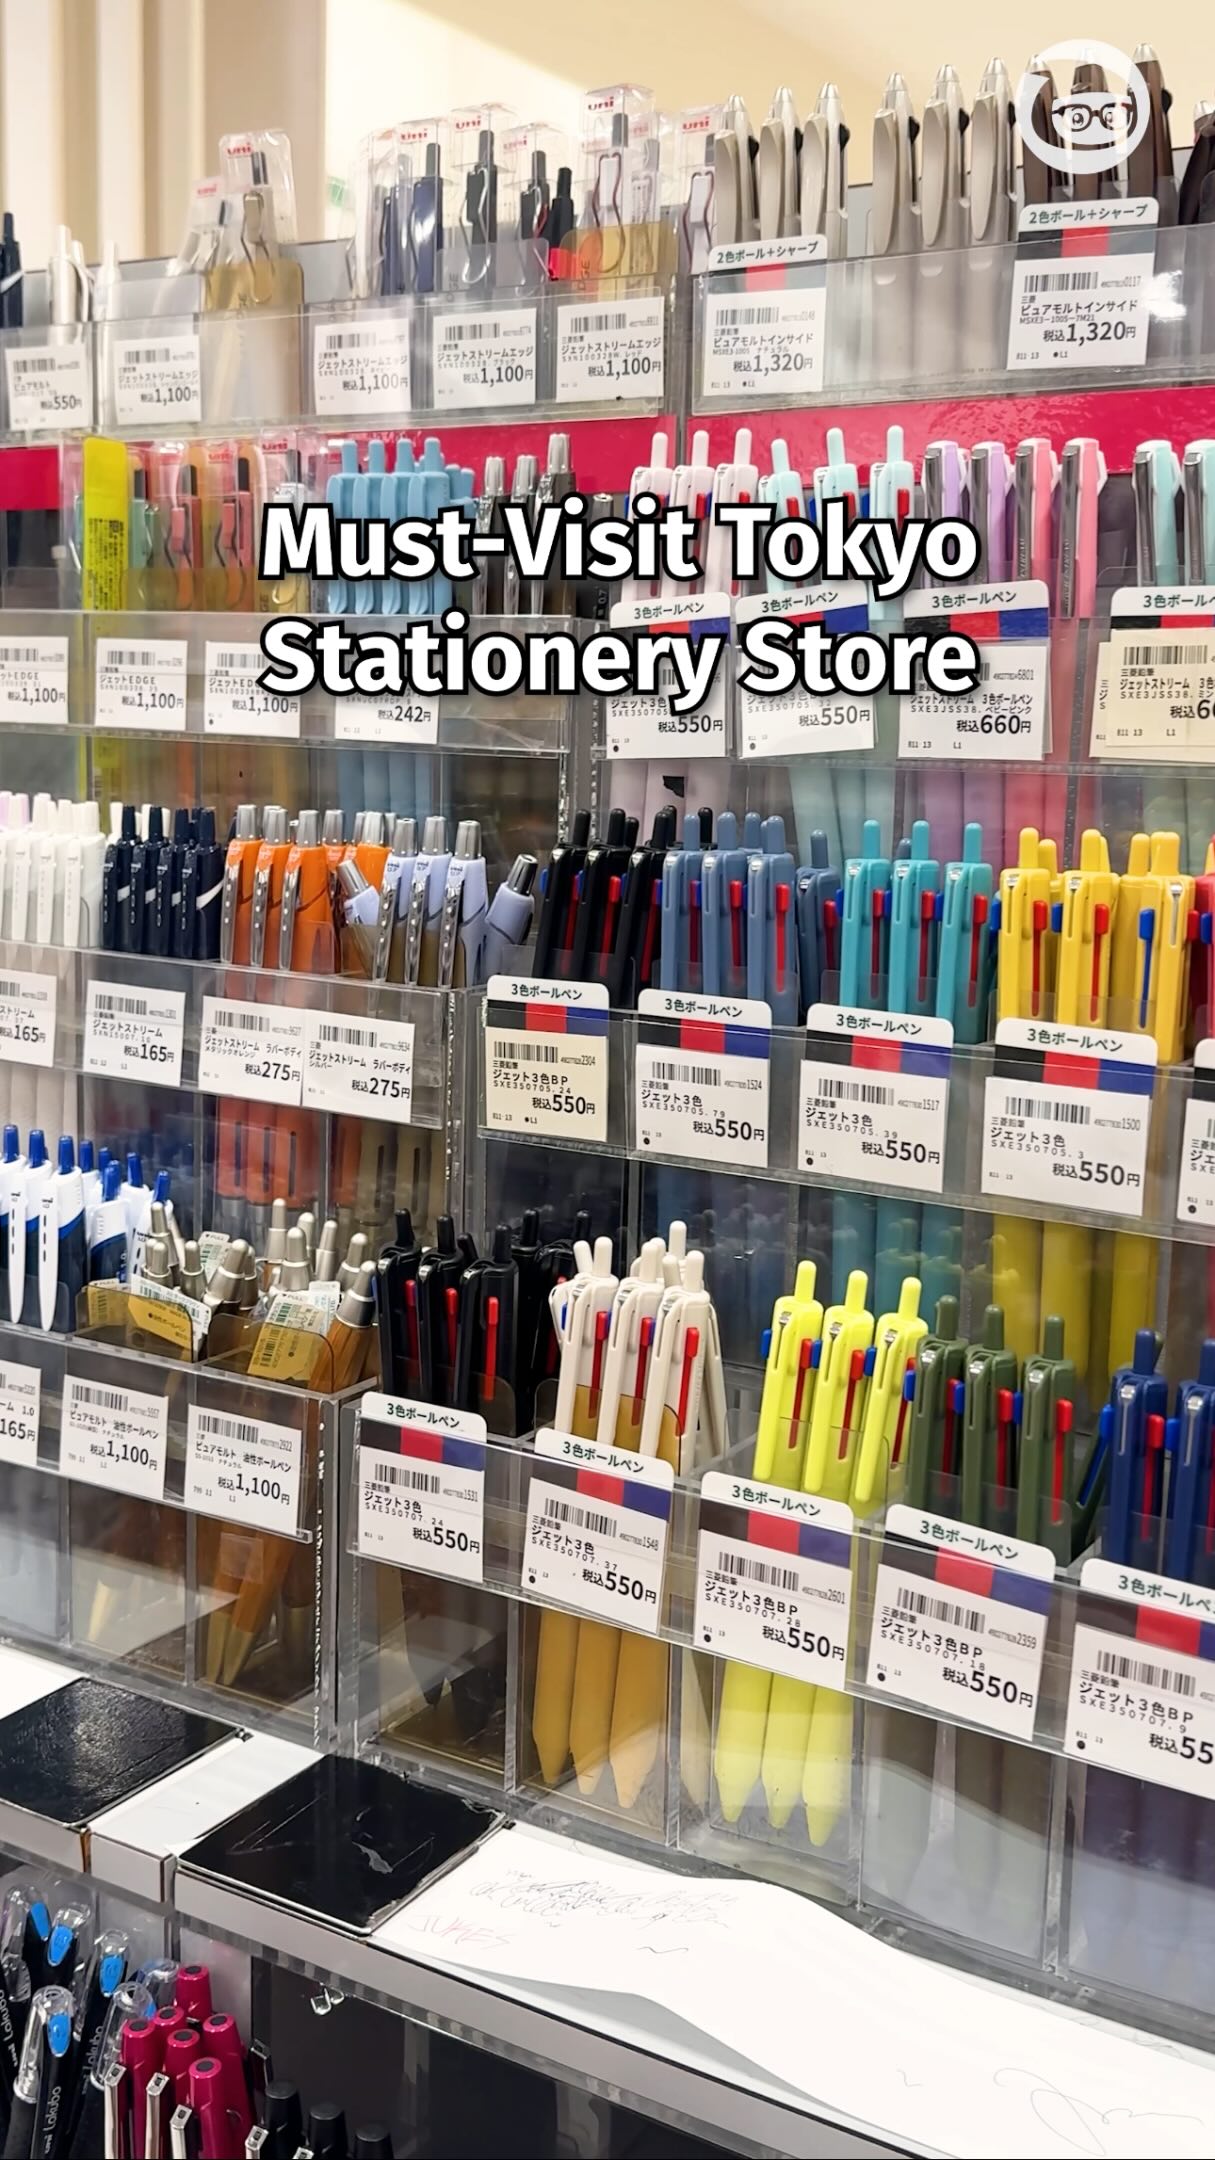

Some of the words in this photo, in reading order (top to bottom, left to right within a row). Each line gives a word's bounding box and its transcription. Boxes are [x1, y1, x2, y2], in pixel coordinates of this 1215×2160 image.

[1020, 299, 1138, 317] ピュアモルトインサイド
[713, 333, 814, 349] ピュアモルトインサイド
[1042, 320, 1136, 346] 税込1,320円
[437, 346, 534, 362] ジェットストリームエッジ
[561, 337, 661, 356] ジェットストリームエッジ
[588, 357, 661, 381] 税込1,100円
[733, 353, 813, 376] 税込1,320円
[342, 373, 408, 394] 税込1,100円
[463, 365, 533, 387] 税込1,100円
[40, 395, 82, 410] 税込550円
[140, 386, 199, 406] 税込1,100円
[761, 590, 839, 613] 3色ボールペン
[932, 591, 1017, 609] 3色ボールペン
[634, 602, 705, 620] 3色ボールペン
[1120, 678, 1190, 690] ジェットストリーム
[8, 688, 66, 705] 税込1,100円
[122, 693, 184, 711] 税込1,100円
[232, 697, 298, 716] 税込1,100円
[378, 705, 431, 722] 税込242円
[658, 715, 723, 733] 税込550円
[799, 705, 870, 726] 税込550円
[956, 715, 1031, 734] 税込660円
[511, 983, 582, 1001] 3色ボールペン
[665, 998, 743, 1018] 3色ボールペン
[93, 1019, 163, 1038] ジェットストリーム
[836, 1014, 922, 1035] 3色ボールペン
[204, 1035, 260, 1052] ジェットストリーム
[1027, 1028, 1124, 1053] 3色ボールペン
[124, 1043, 175, 1062] 税込165円
[309, 1051, 366, 1068] ジェットストリーム
[373, 1059, 411, 1075] ラバーボディ
[244, 1061, 301, 1082] 税込275円
[309, 1060, 332, 1070] シルバー
[493, 1069, 568, 1085] ジェット3色BP
[351, 1077, 410, 1099] 税込275円
[641, 1088, 703, 1107] ジェット3色
[532, 1093, 596, 1115] 税込550円
[805, 1107, 873, 1128] ジェット3色
[693, 1118, 765, 1142] 税込550円
[990, 1127, 1065, 1148] ジェット3色
[861, 1139, 940, 1165] 税込550円
[1052, 1161, 1141, 1188] 税込550円
[22, 1405, 35, 1416] 1.0
[70, 1410, 107, 1427] ピュアモルト
[387, 1402, 460, 1428] 3色ボールペン
[90, 1440, 158, 1471] 税込1,100円
[196, 1441, 237, 1459] ピュアモルト
[562, 1441, 644, 1474] 3色ボールペン
[218, 1473, 290, 1505] 税込1,100円
[364, 1491, 422, 1514] ジェット3色
[731, 1485, 821, 1517] 3色ボールペン
[412, 1526, 480, 1554] 税込550円
[531, 1524, 595, 1555] ジェット3色
[919, 1520, 1019, 1560] 3色ボールペン
[582, 1569, 657, 1605] 税込550円
[704, 1580, 799, 1616] ジェット3色BP
[762, 1625, 845, 1661] 税込550円
[880, 1618, 983, 1658] ジェット3色BP
[942, 1666, 1033, 1708] 税込550円
[1079, 1681, 1194, 1724] ジェット3色BP
